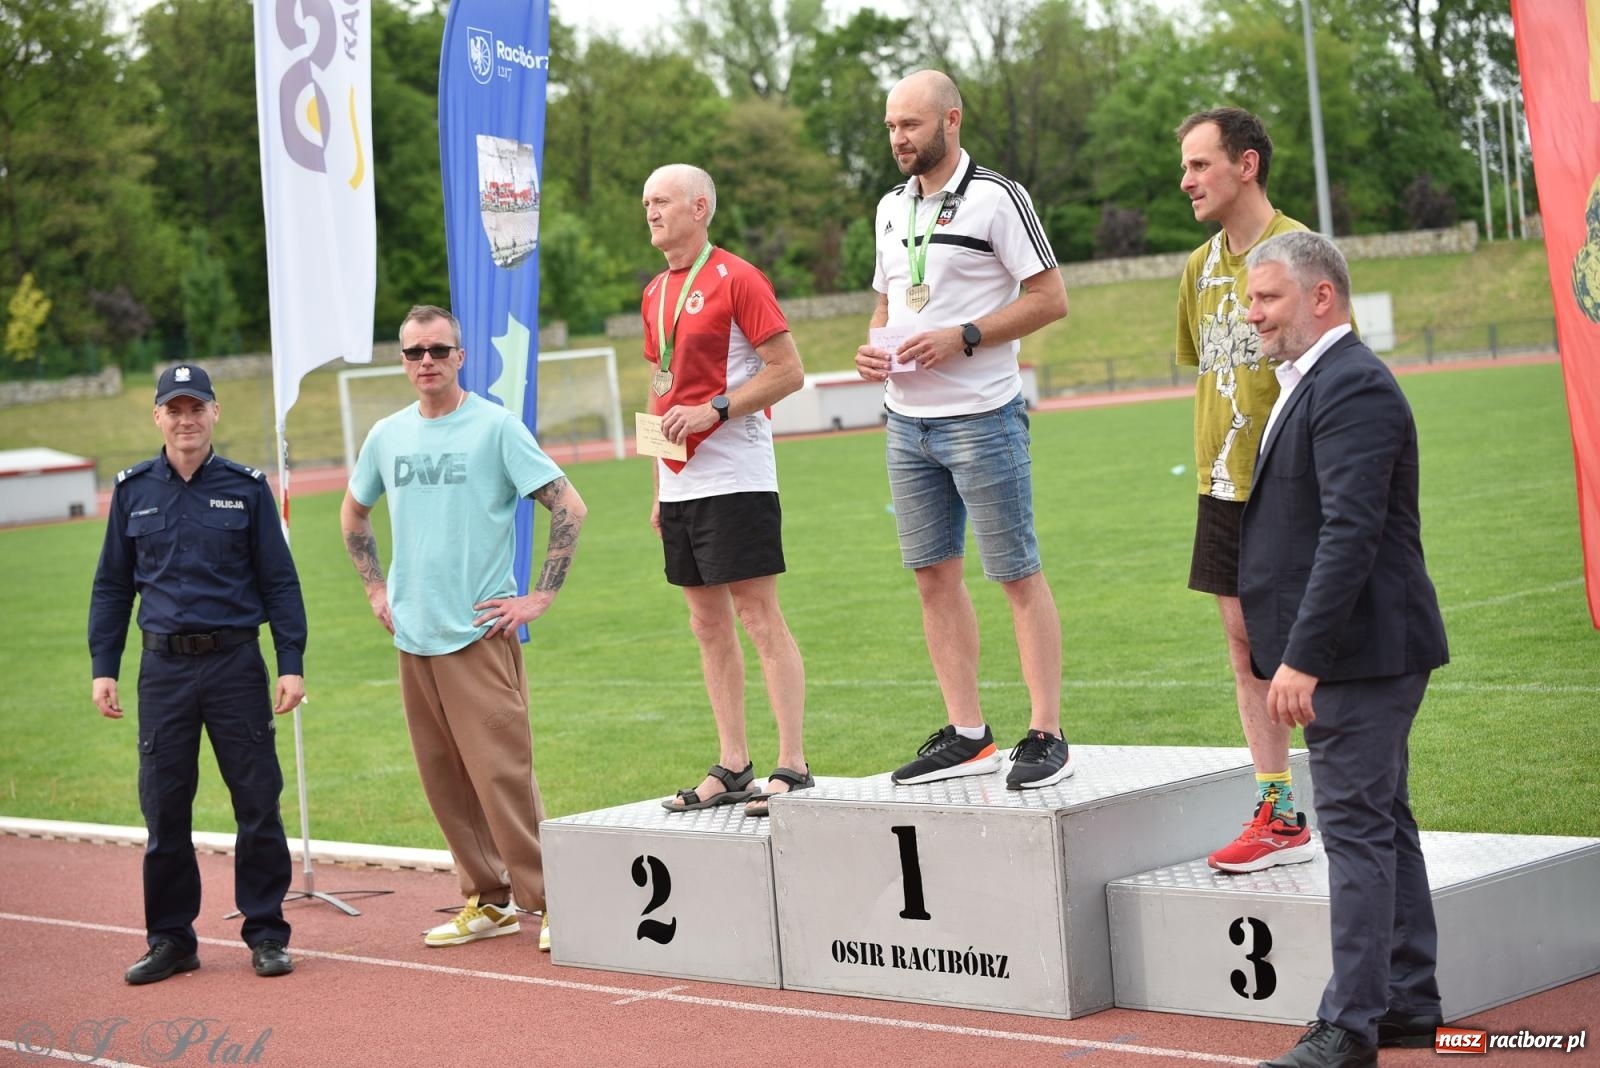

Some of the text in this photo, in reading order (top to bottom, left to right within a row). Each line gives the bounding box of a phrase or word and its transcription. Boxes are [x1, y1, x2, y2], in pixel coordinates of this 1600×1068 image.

[341, 0, 361, 61] RA
[209, 499, 245, 511] POLICJA
[631, 854, 677, 945] 2
[891, 825, 931, 920] 1
[831, 939, 1010, 979] OSIR RACIBÓRZ
[1228, 916, 1277, 1000] 3
